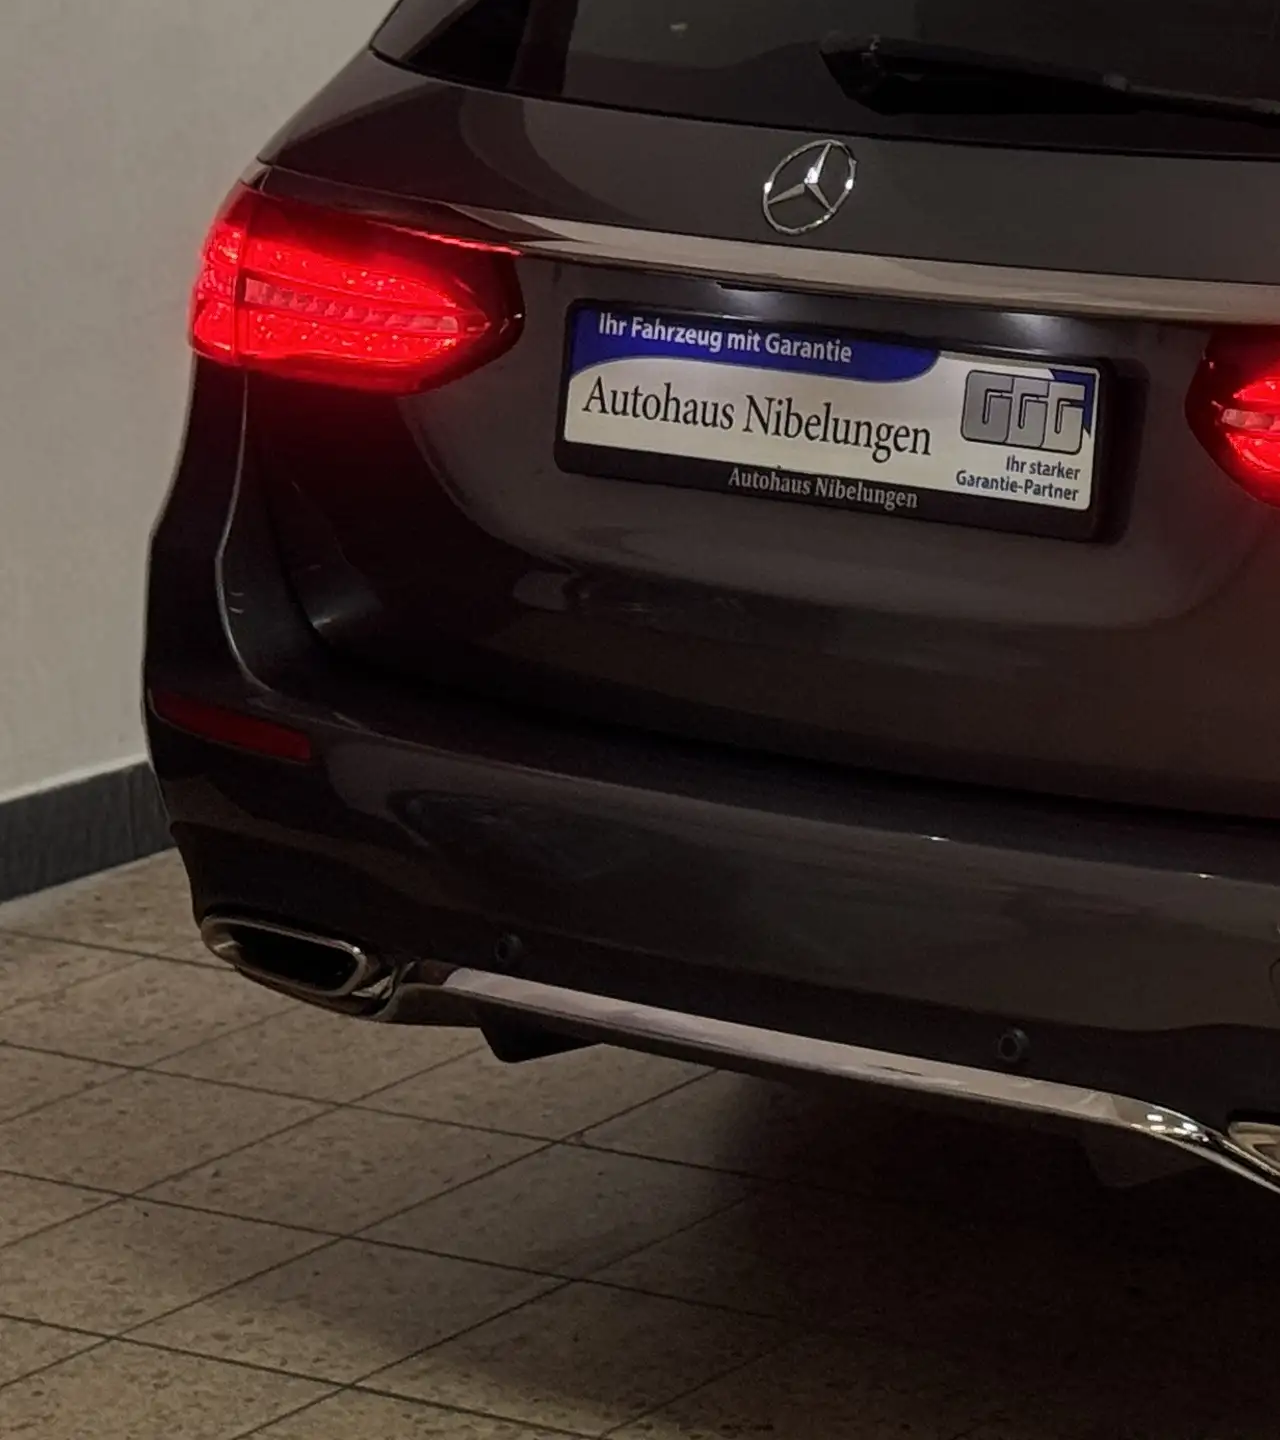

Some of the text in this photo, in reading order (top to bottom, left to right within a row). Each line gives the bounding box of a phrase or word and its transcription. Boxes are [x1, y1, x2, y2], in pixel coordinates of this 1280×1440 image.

[600, 312, 852, 363] Ihr Fahrzeug mit Garantie
[582, 375, 931, 464] Autohaus Nibelungen
[728, 467, 918, 511] Autohaus Nibelungen
[956, 469, 1080, 501] Garantie-Partner
[1005, 455, 1081, 481] Ihr starker
